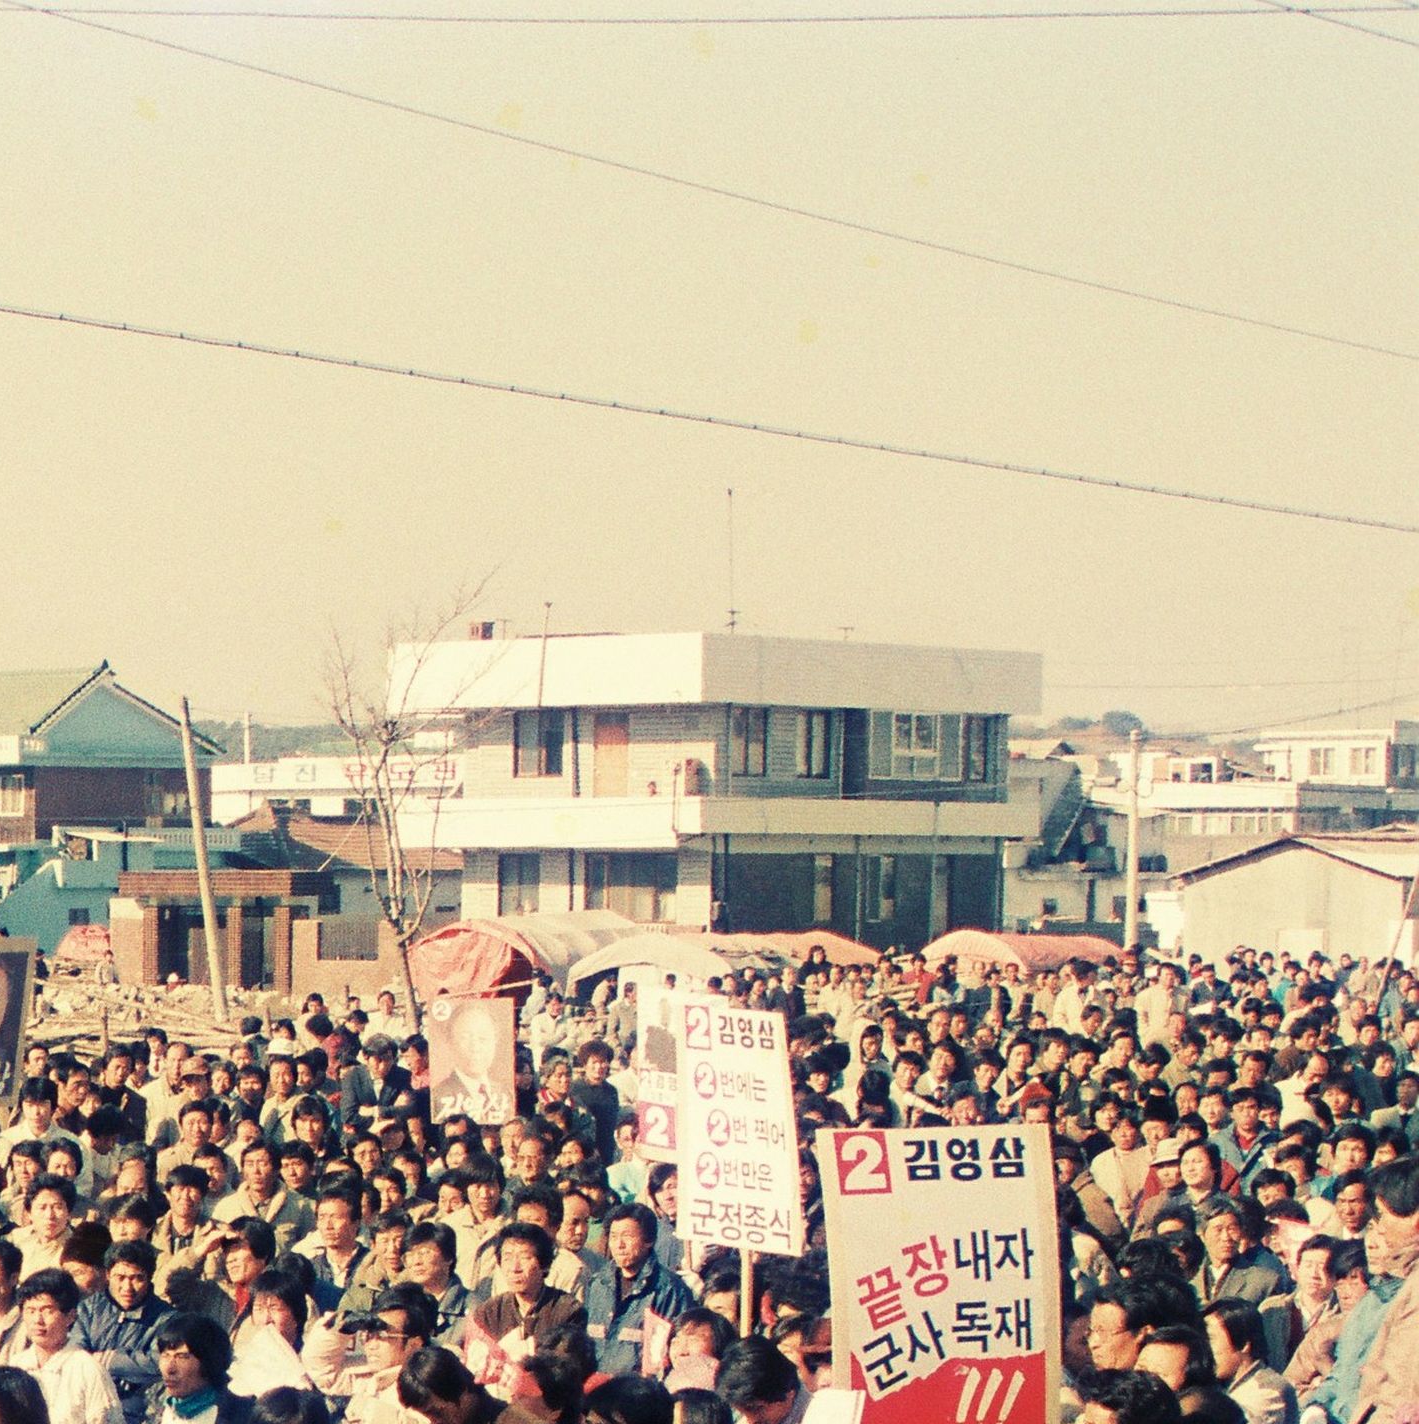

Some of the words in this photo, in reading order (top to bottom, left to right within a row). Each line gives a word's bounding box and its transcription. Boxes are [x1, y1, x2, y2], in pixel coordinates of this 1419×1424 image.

[686, 1007, 710, 1048] 2
[717, 1015, 775, 1050] 김영삼
[645, 1105, 669, 1147] 2
[840, 1135, 888, 1191] 2
[903, 1136, 1025, 1181] 김영삼
[691, 1198, 792, 1250] 군정종식
